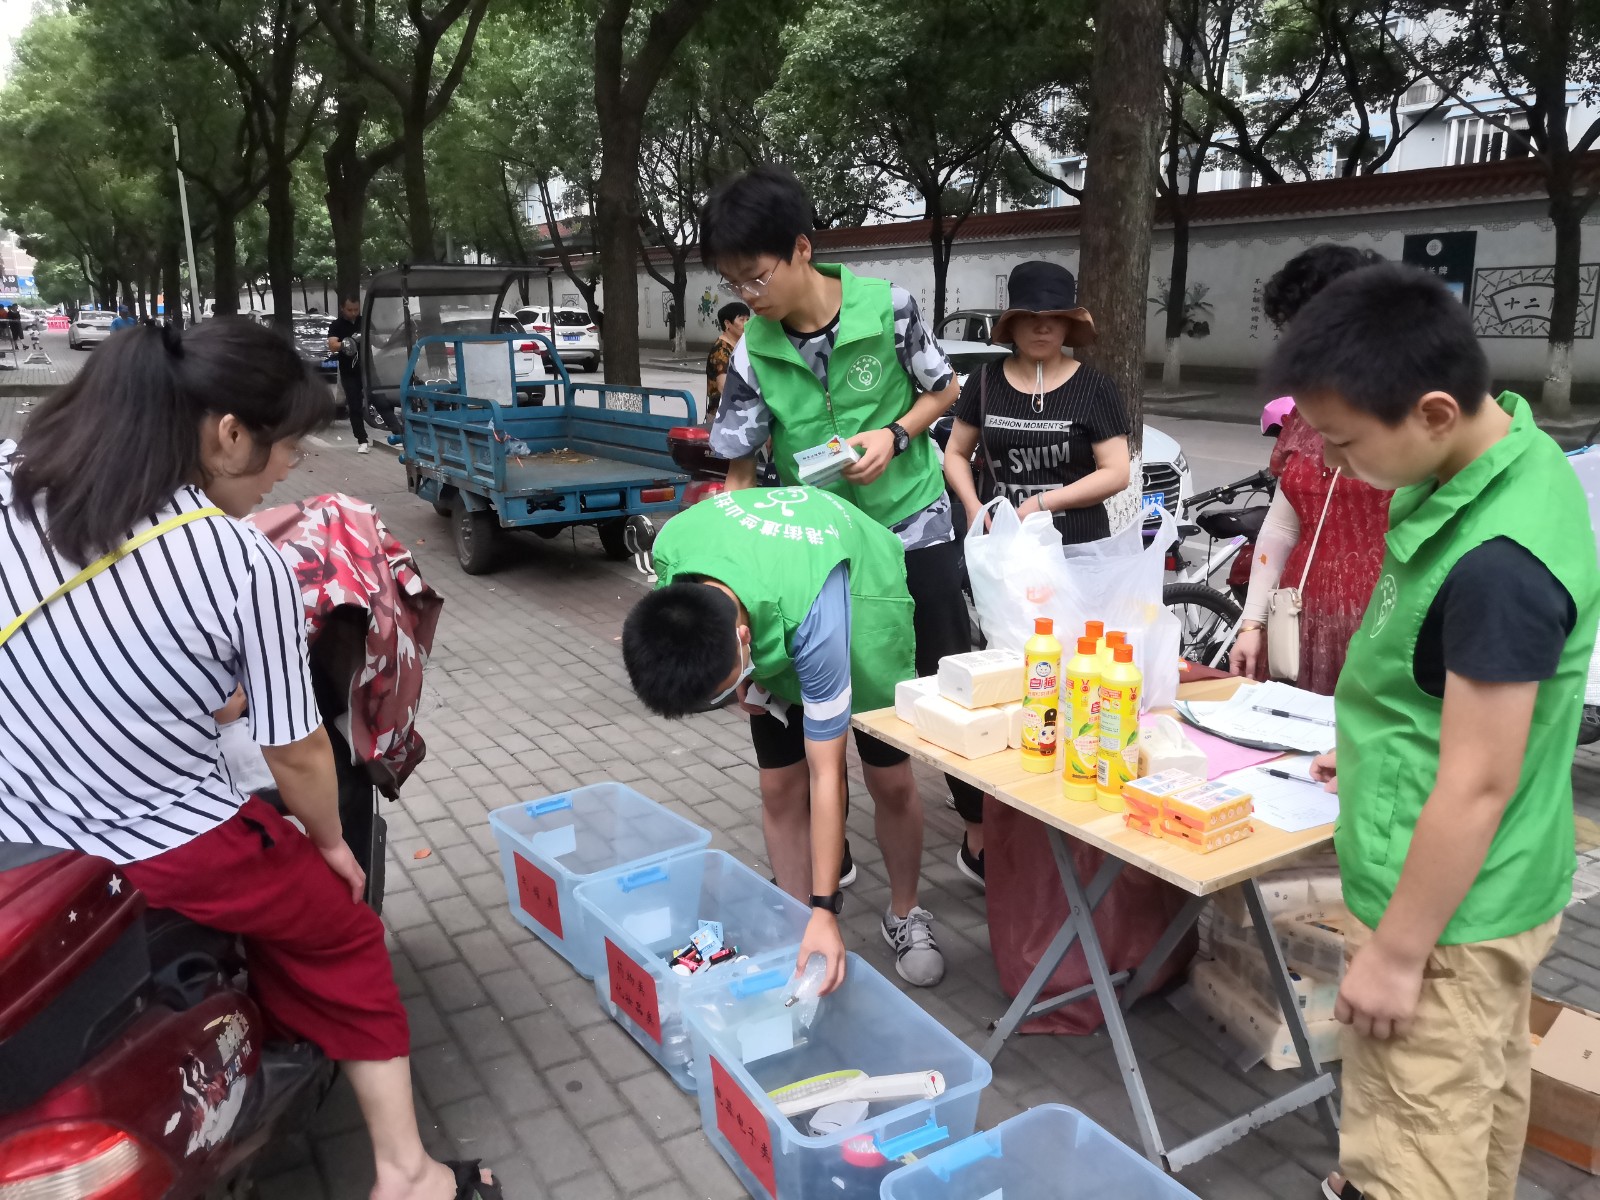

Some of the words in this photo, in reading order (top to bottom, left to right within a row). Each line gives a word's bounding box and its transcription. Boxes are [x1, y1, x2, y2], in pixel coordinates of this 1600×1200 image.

[1504, 297, 1554, 312] 十二
[988, 417, 1022, 429] FASHION
[1023, 420, 1064, 430] MOMENTS
[1008, 441, 1071, 474] SWIM
[1029, 676, 1057, 690] 白猫
